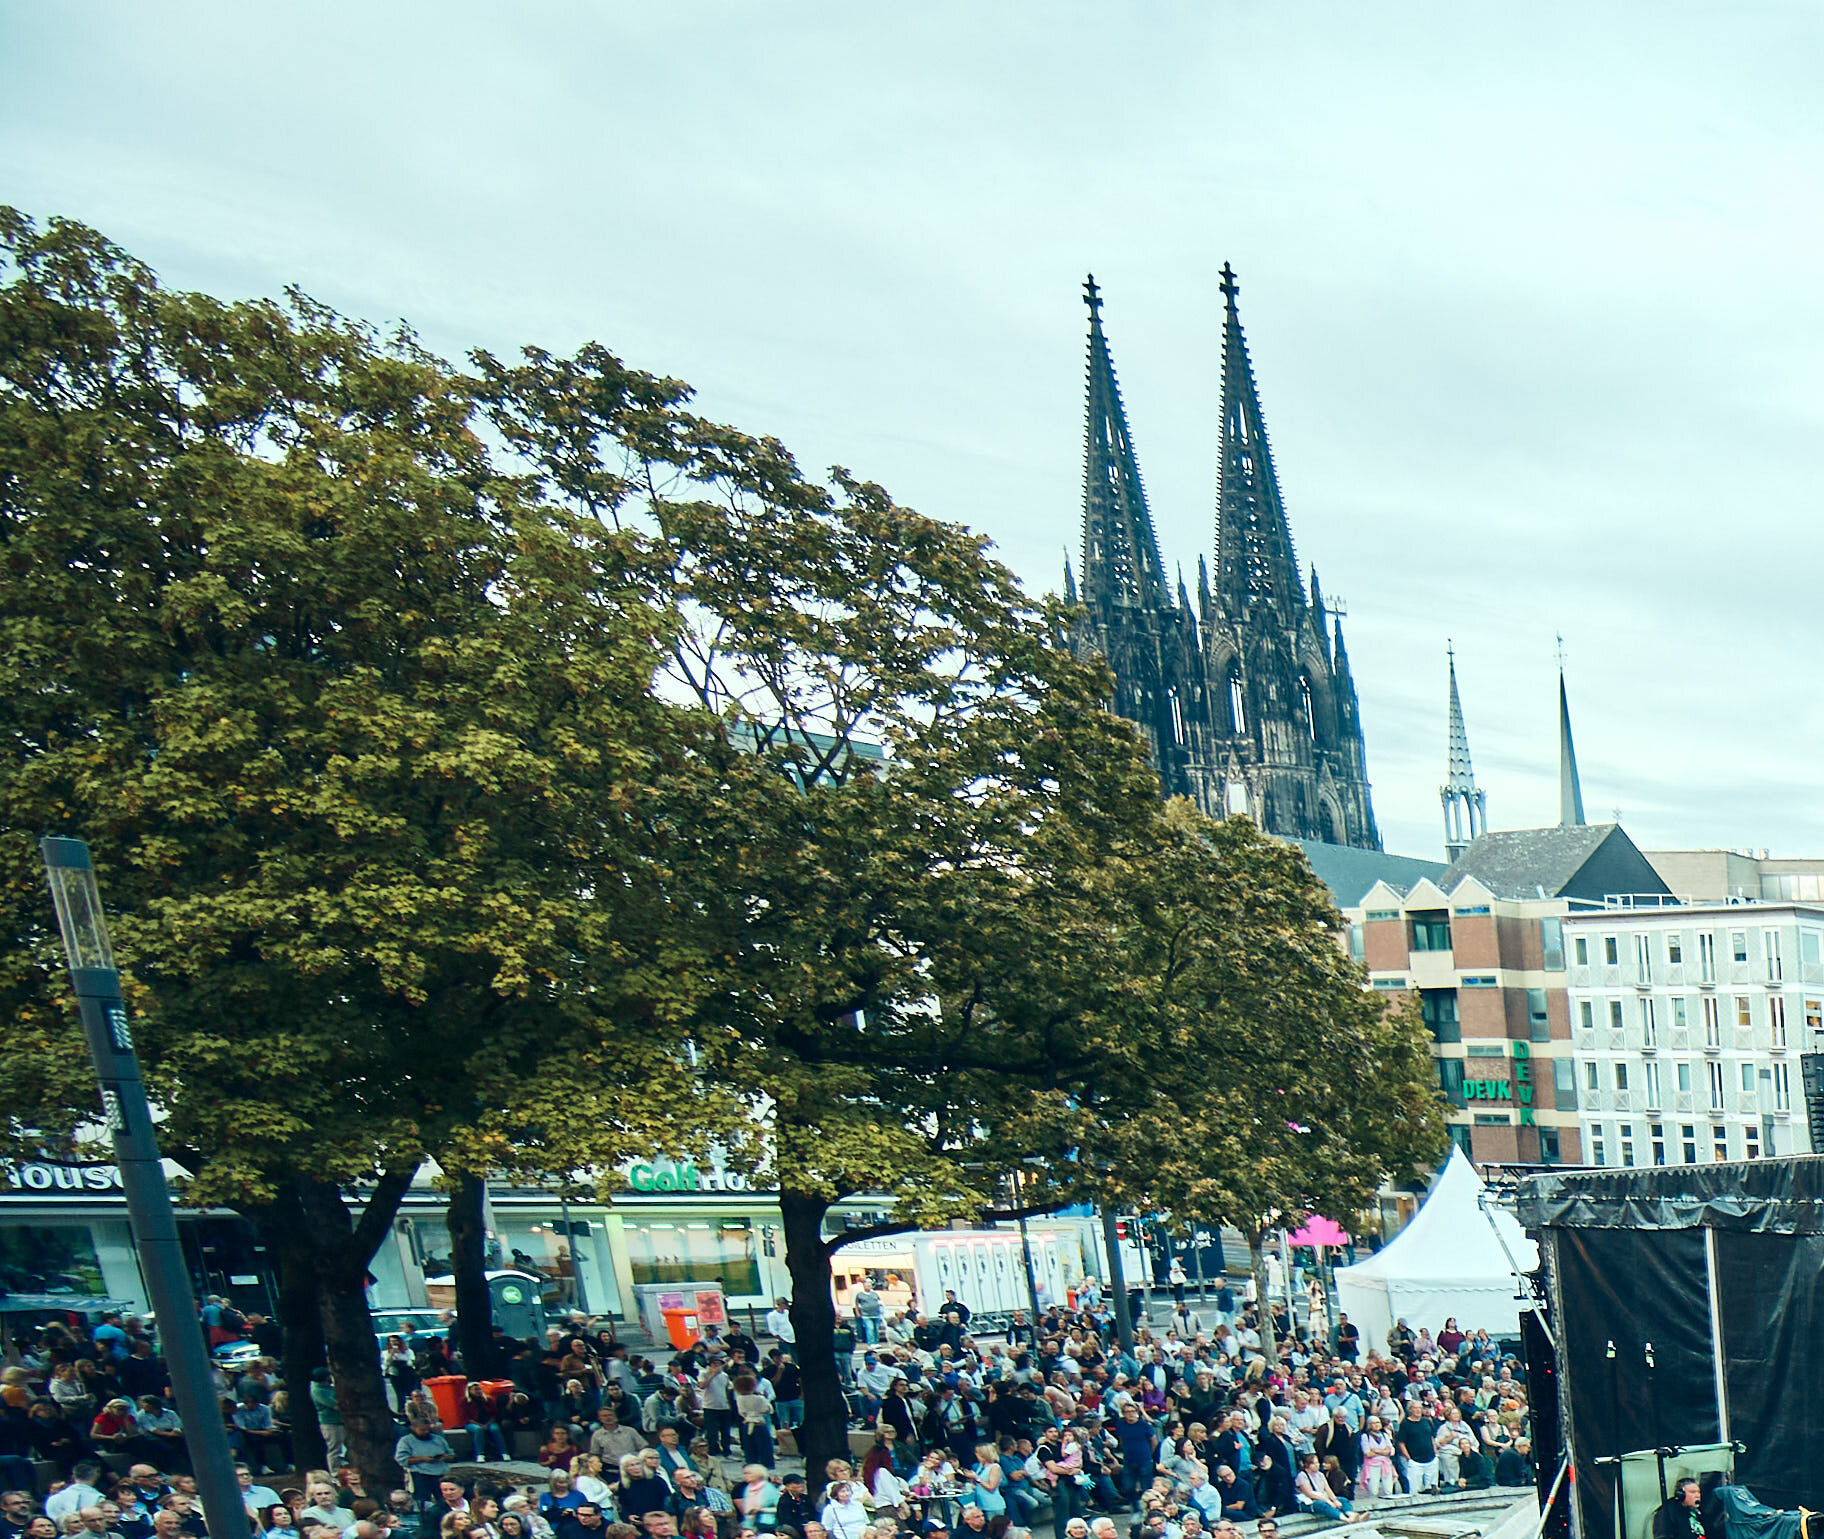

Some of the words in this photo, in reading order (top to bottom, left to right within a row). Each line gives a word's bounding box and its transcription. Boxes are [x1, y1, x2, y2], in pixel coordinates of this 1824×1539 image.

[1463, 1080, 1511, 1099] DEVK
[1513, 1041, 1535, 1126] DEVK
[4, 1158, 124, 1190] ous
